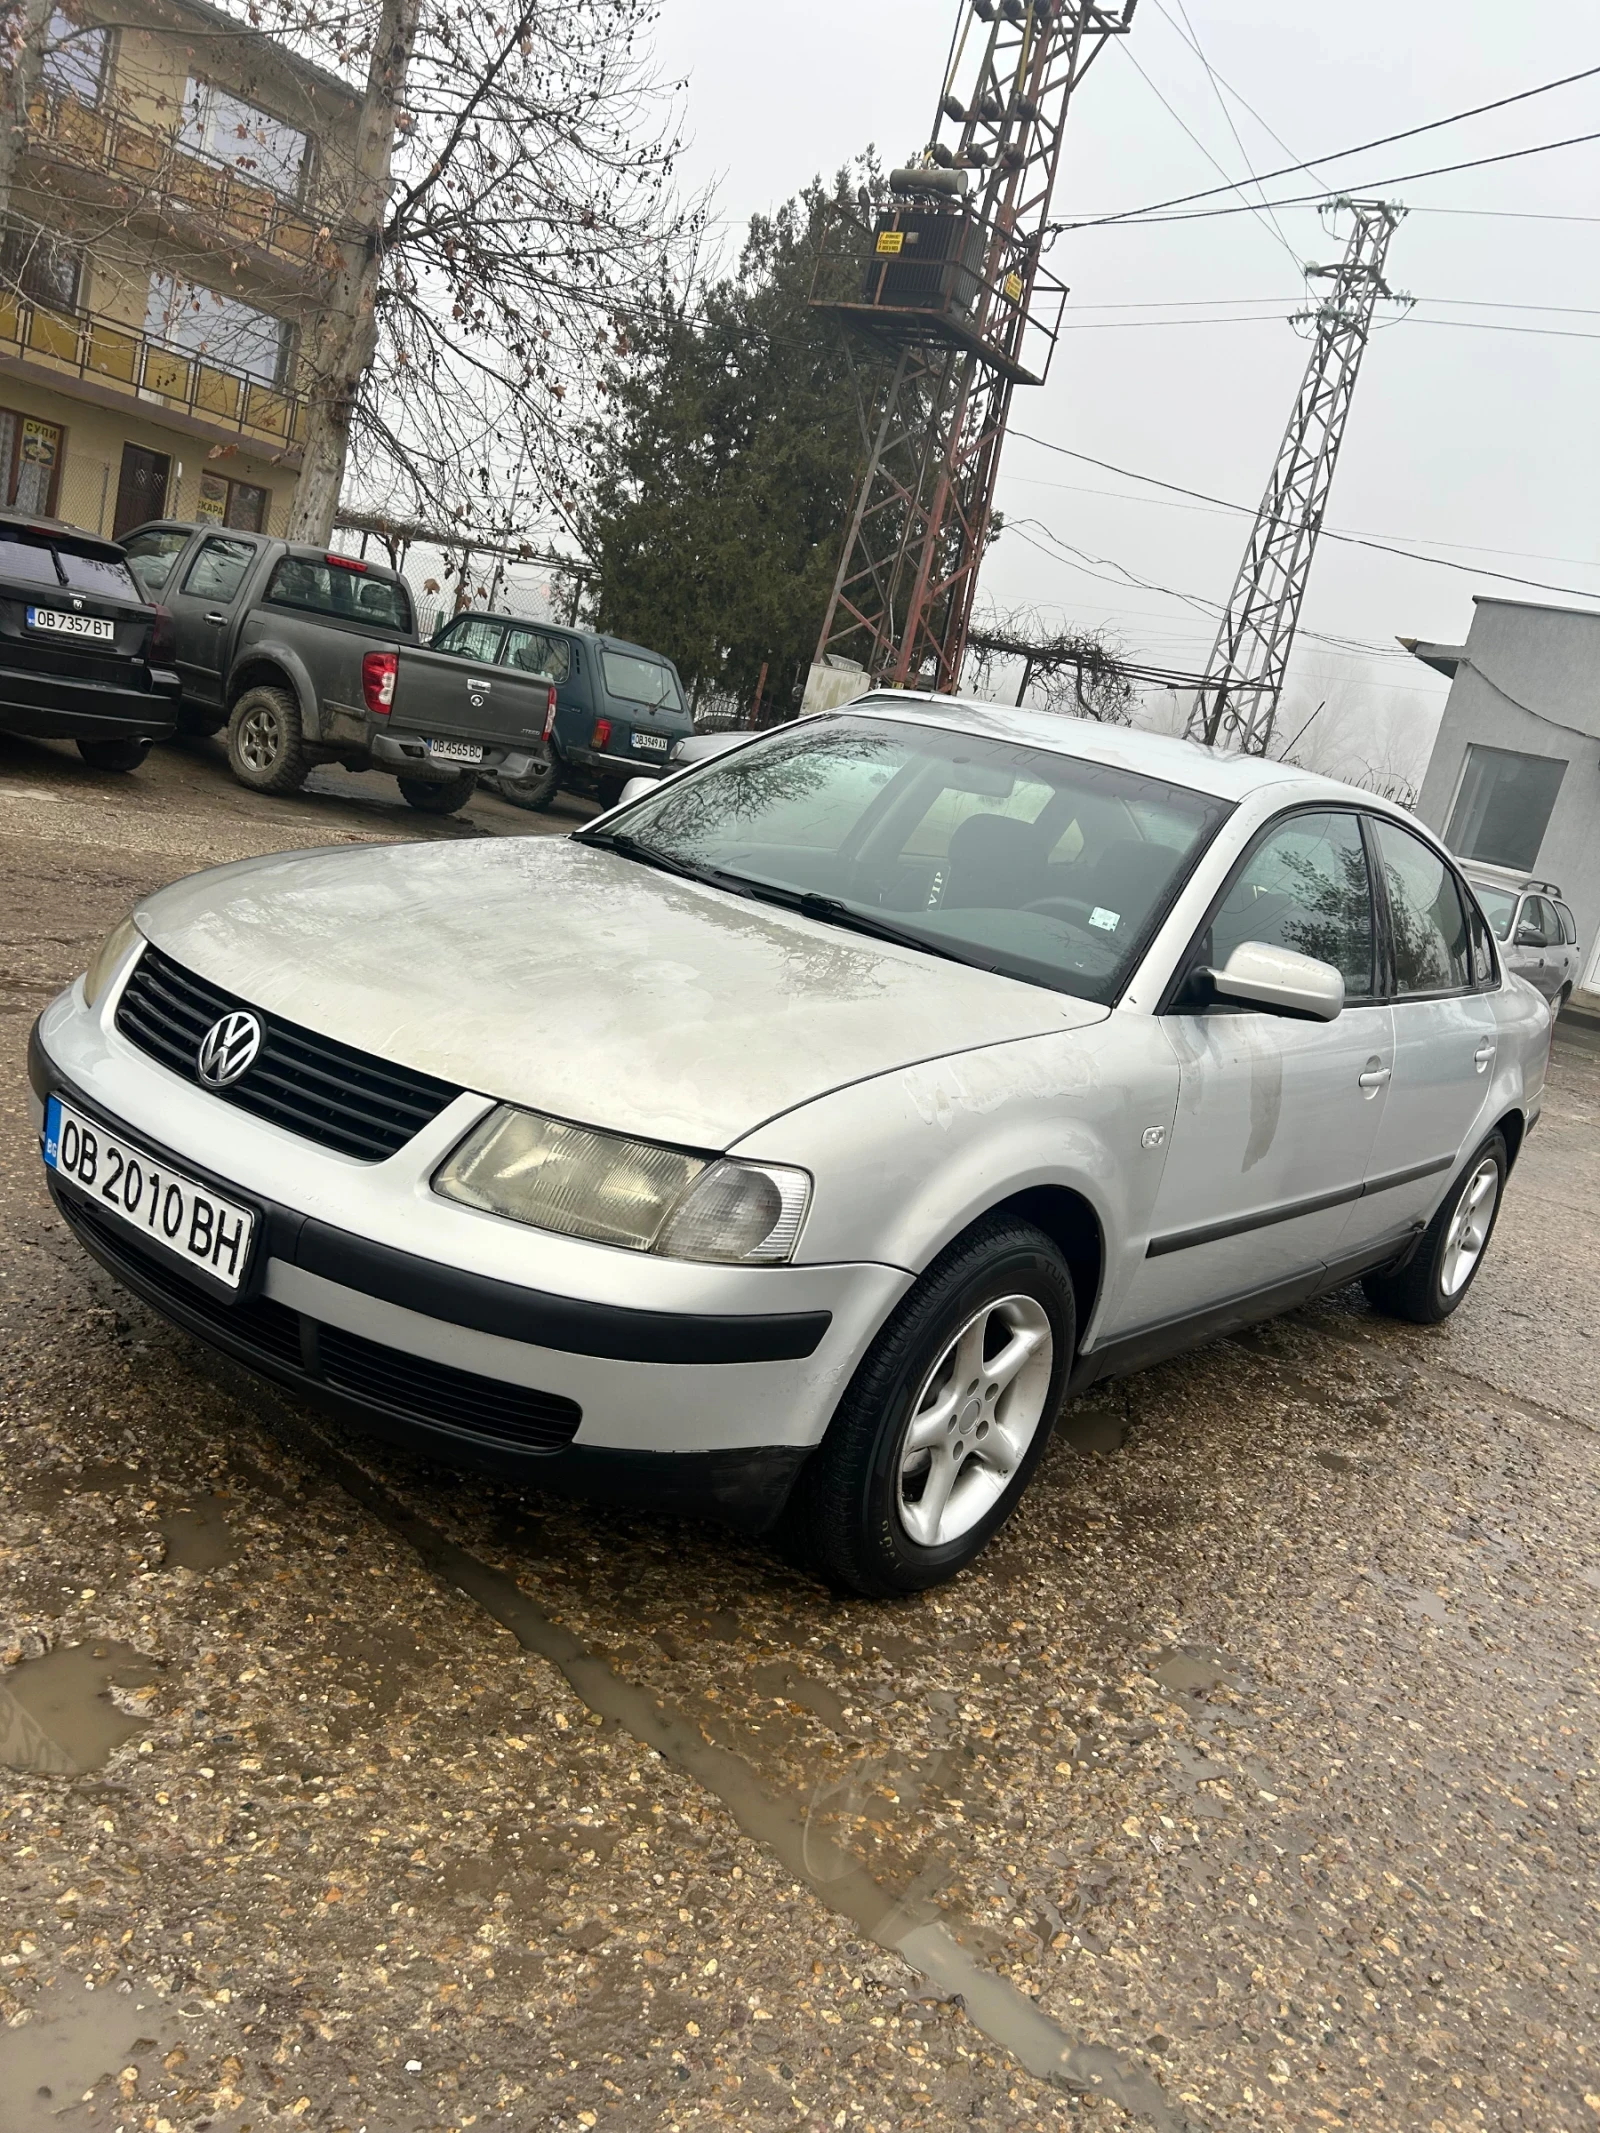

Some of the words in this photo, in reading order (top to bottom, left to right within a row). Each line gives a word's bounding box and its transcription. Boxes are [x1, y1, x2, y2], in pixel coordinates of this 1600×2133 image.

[26, 422, 57, 440] СУПИ
[37, 611, 55, 627] OB
[57, 614, 91, 633] 7357
[93, 621, 112, 637] BT
[432, 740, 445, 752] OB
[445, 742, 468, 756] 4565
[469, 745, 481, 758] BC
[928, 871, 943, 905] VIP
[46, 1137, 58, 1158] BG
[61, 1120, 98, 1186] OB
[102, 1146, 184, 1238] 2010
[188, 1196, 244, 1276] BH
